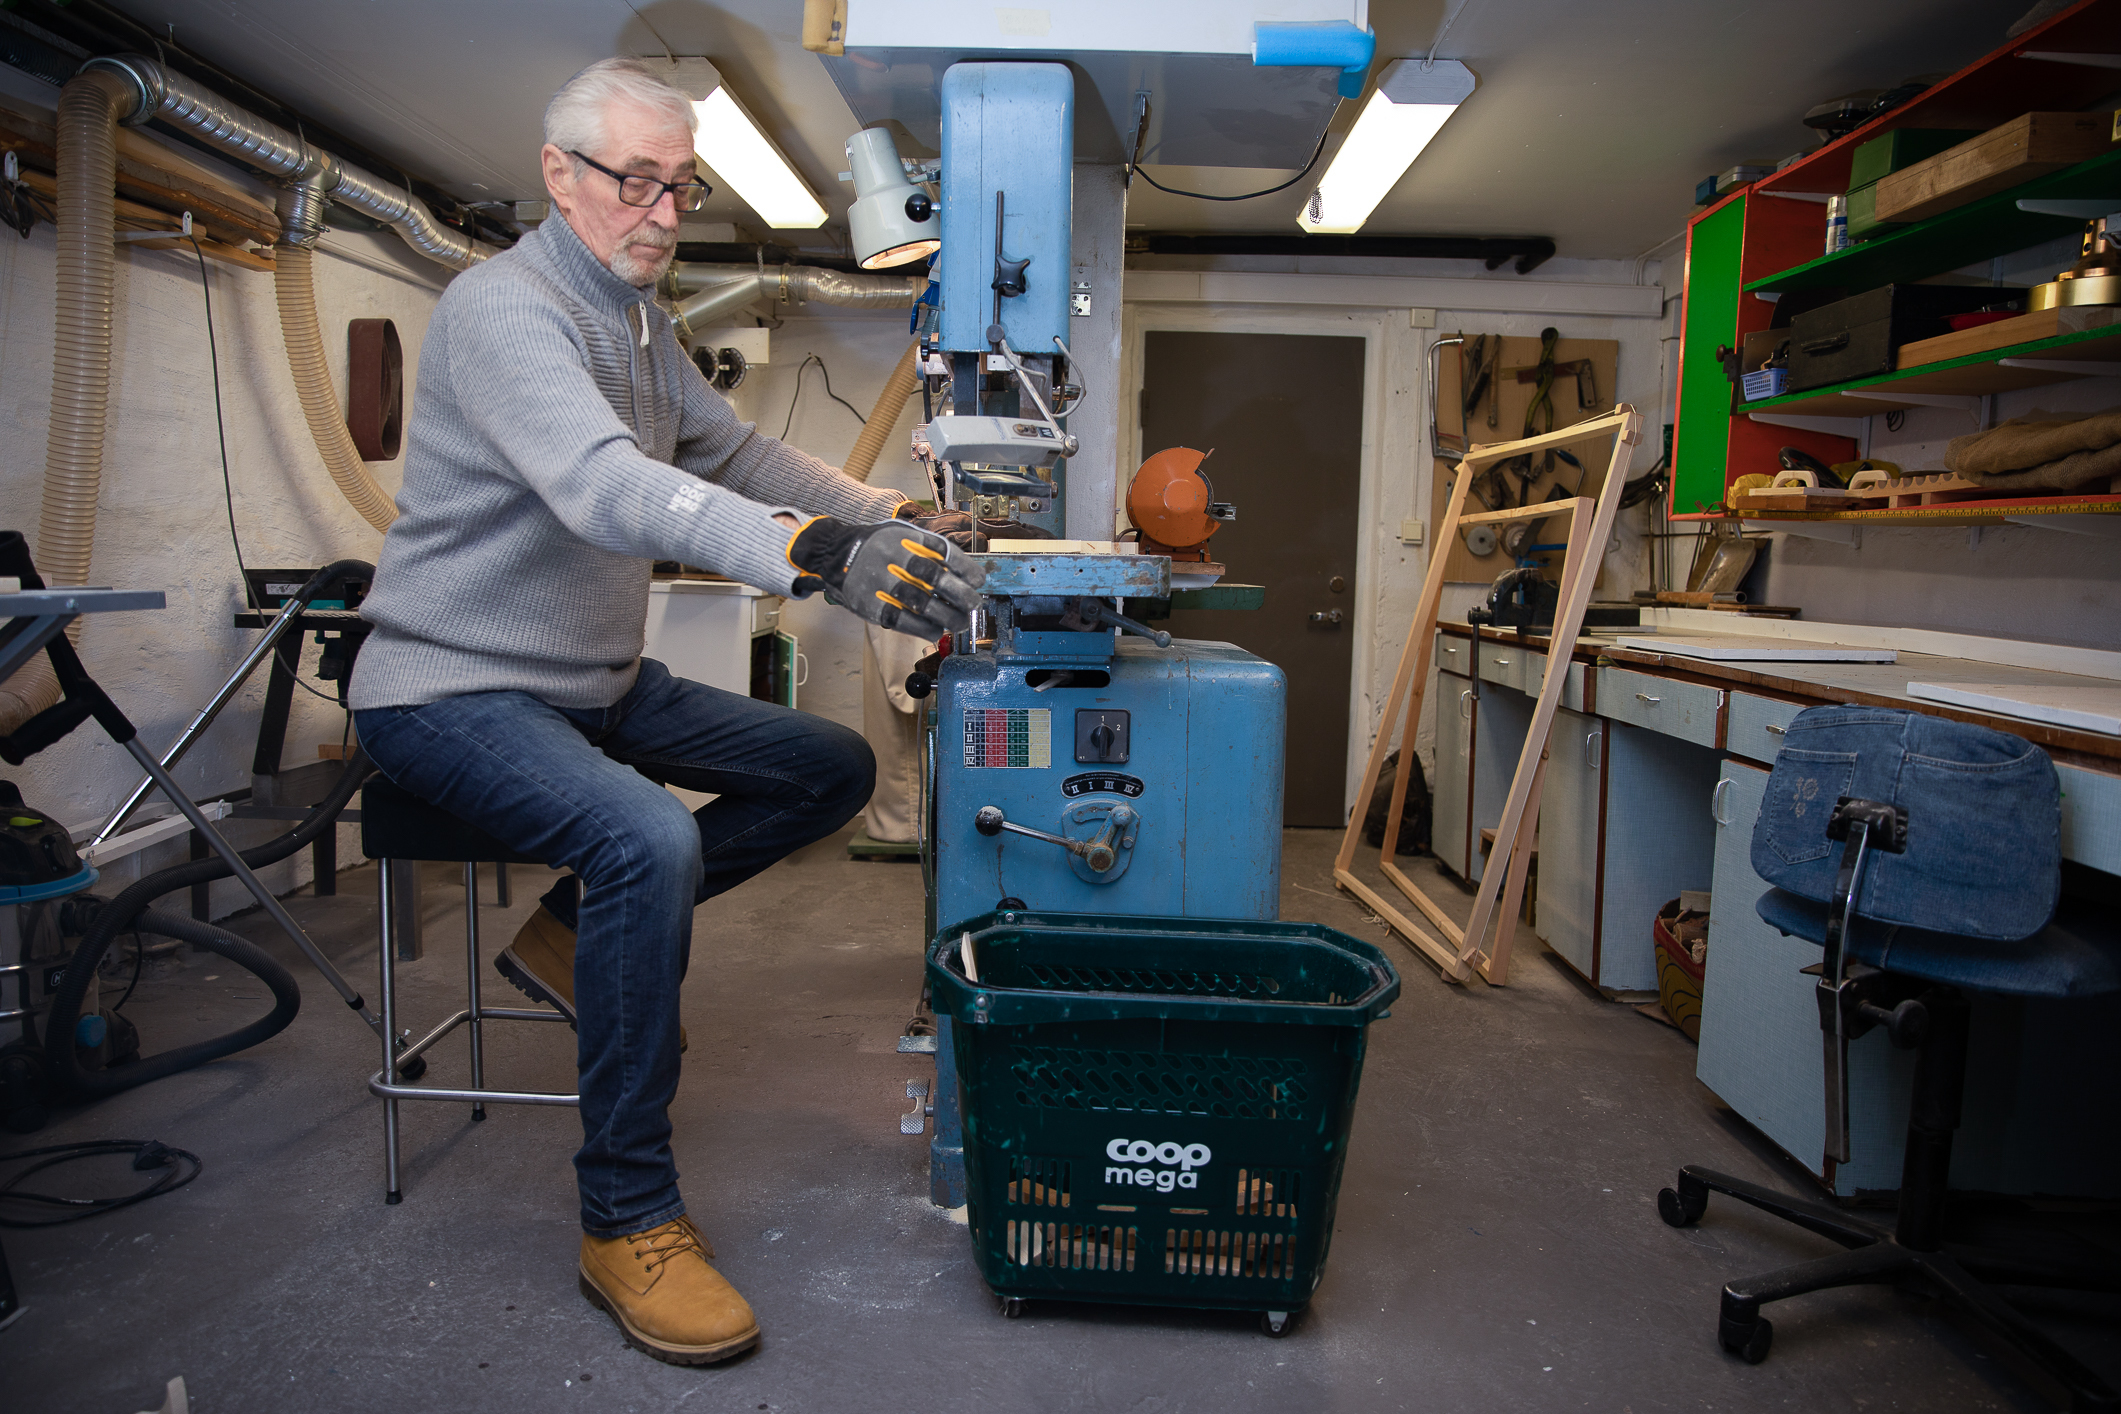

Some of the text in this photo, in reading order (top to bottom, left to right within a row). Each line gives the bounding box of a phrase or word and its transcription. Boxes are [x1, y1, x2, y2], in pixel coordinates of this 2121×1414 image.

[966, 734, 973, 742] II
[965, 745, 974, 753] III
[1072, 785, 1080, 794] II
[1088, 781, 1093, 790] I
[1104, 781, 1114, 790] III
[1124, 784, 1135, 794] IV
[1106, 1138, 1211, 1171] coop
[1105, 1167, 1198, 1193] mega
